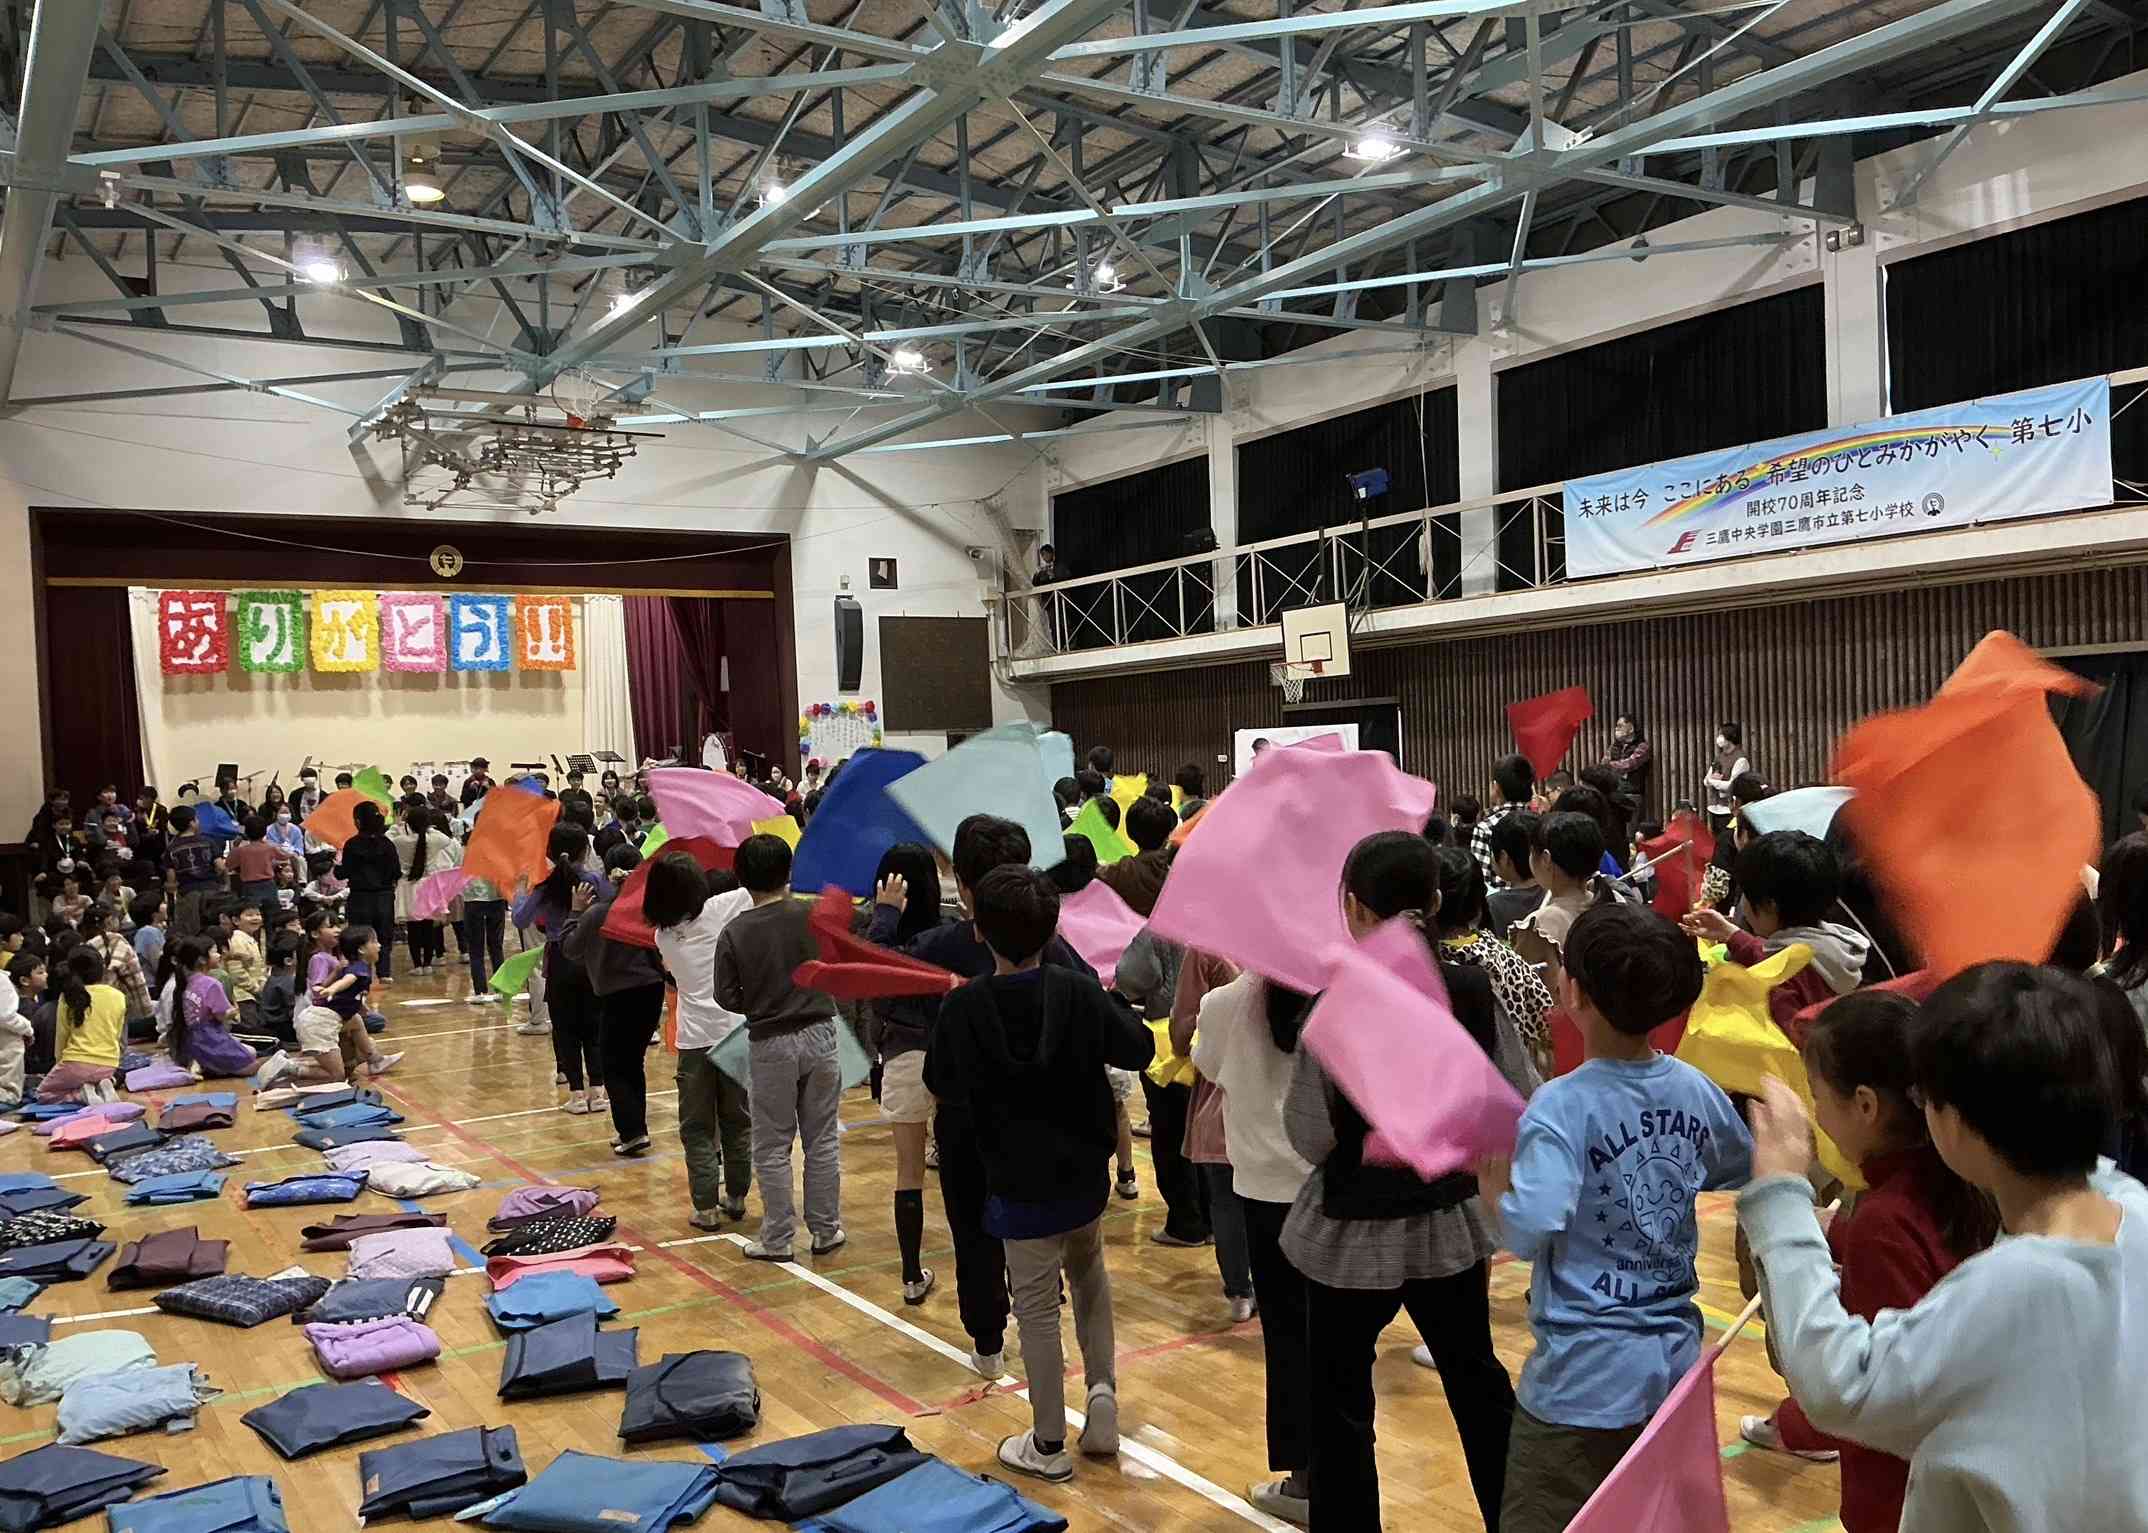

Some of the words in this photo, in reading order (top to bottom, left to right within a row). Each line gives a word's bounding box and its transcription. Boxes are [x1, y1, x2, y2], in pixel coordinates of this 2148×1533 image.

[1578, 488, 1649, 519] 未来は今
[1664, 469, 1750, 502] ここにある
[1767, 424, 1989, 487] 希望のひとみかがやく
[2011, 407, 2092, 444] 第七小
[1705, 500, 1915, 545] 三鷹中央学園三鷹市立第七小学校
[1746, 483, 1865, 518] 開校70周年記念
[1588, 1121, 1639, 1174] ALL
